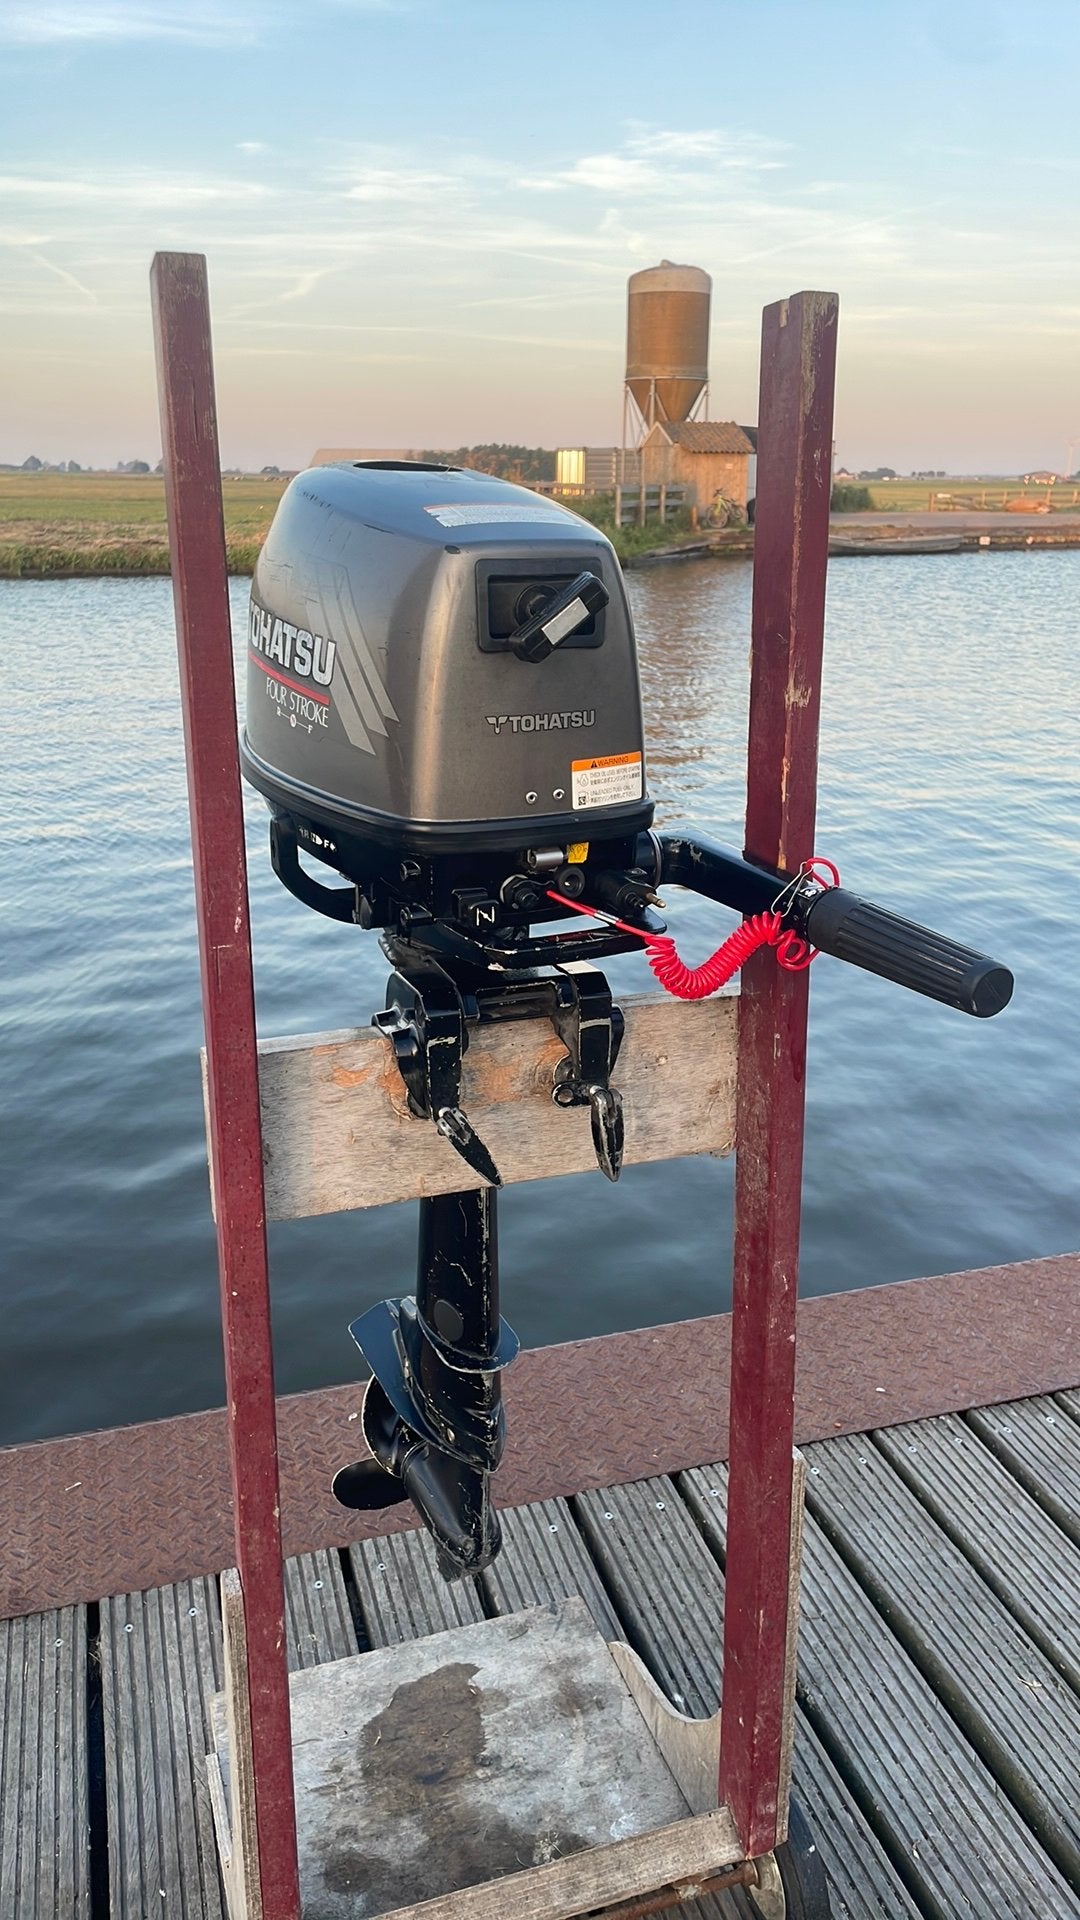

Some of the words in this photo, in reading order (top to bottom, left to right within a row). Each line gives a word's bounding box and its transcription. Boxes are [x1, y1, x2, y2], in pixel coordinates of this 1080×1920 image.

[266, 677, 287, 706] FOUR
[290, 692, 329, 728] STROKE
[509, 710, 595, 733] TOHATSU
[598, 756, 629, 767] WARNING
